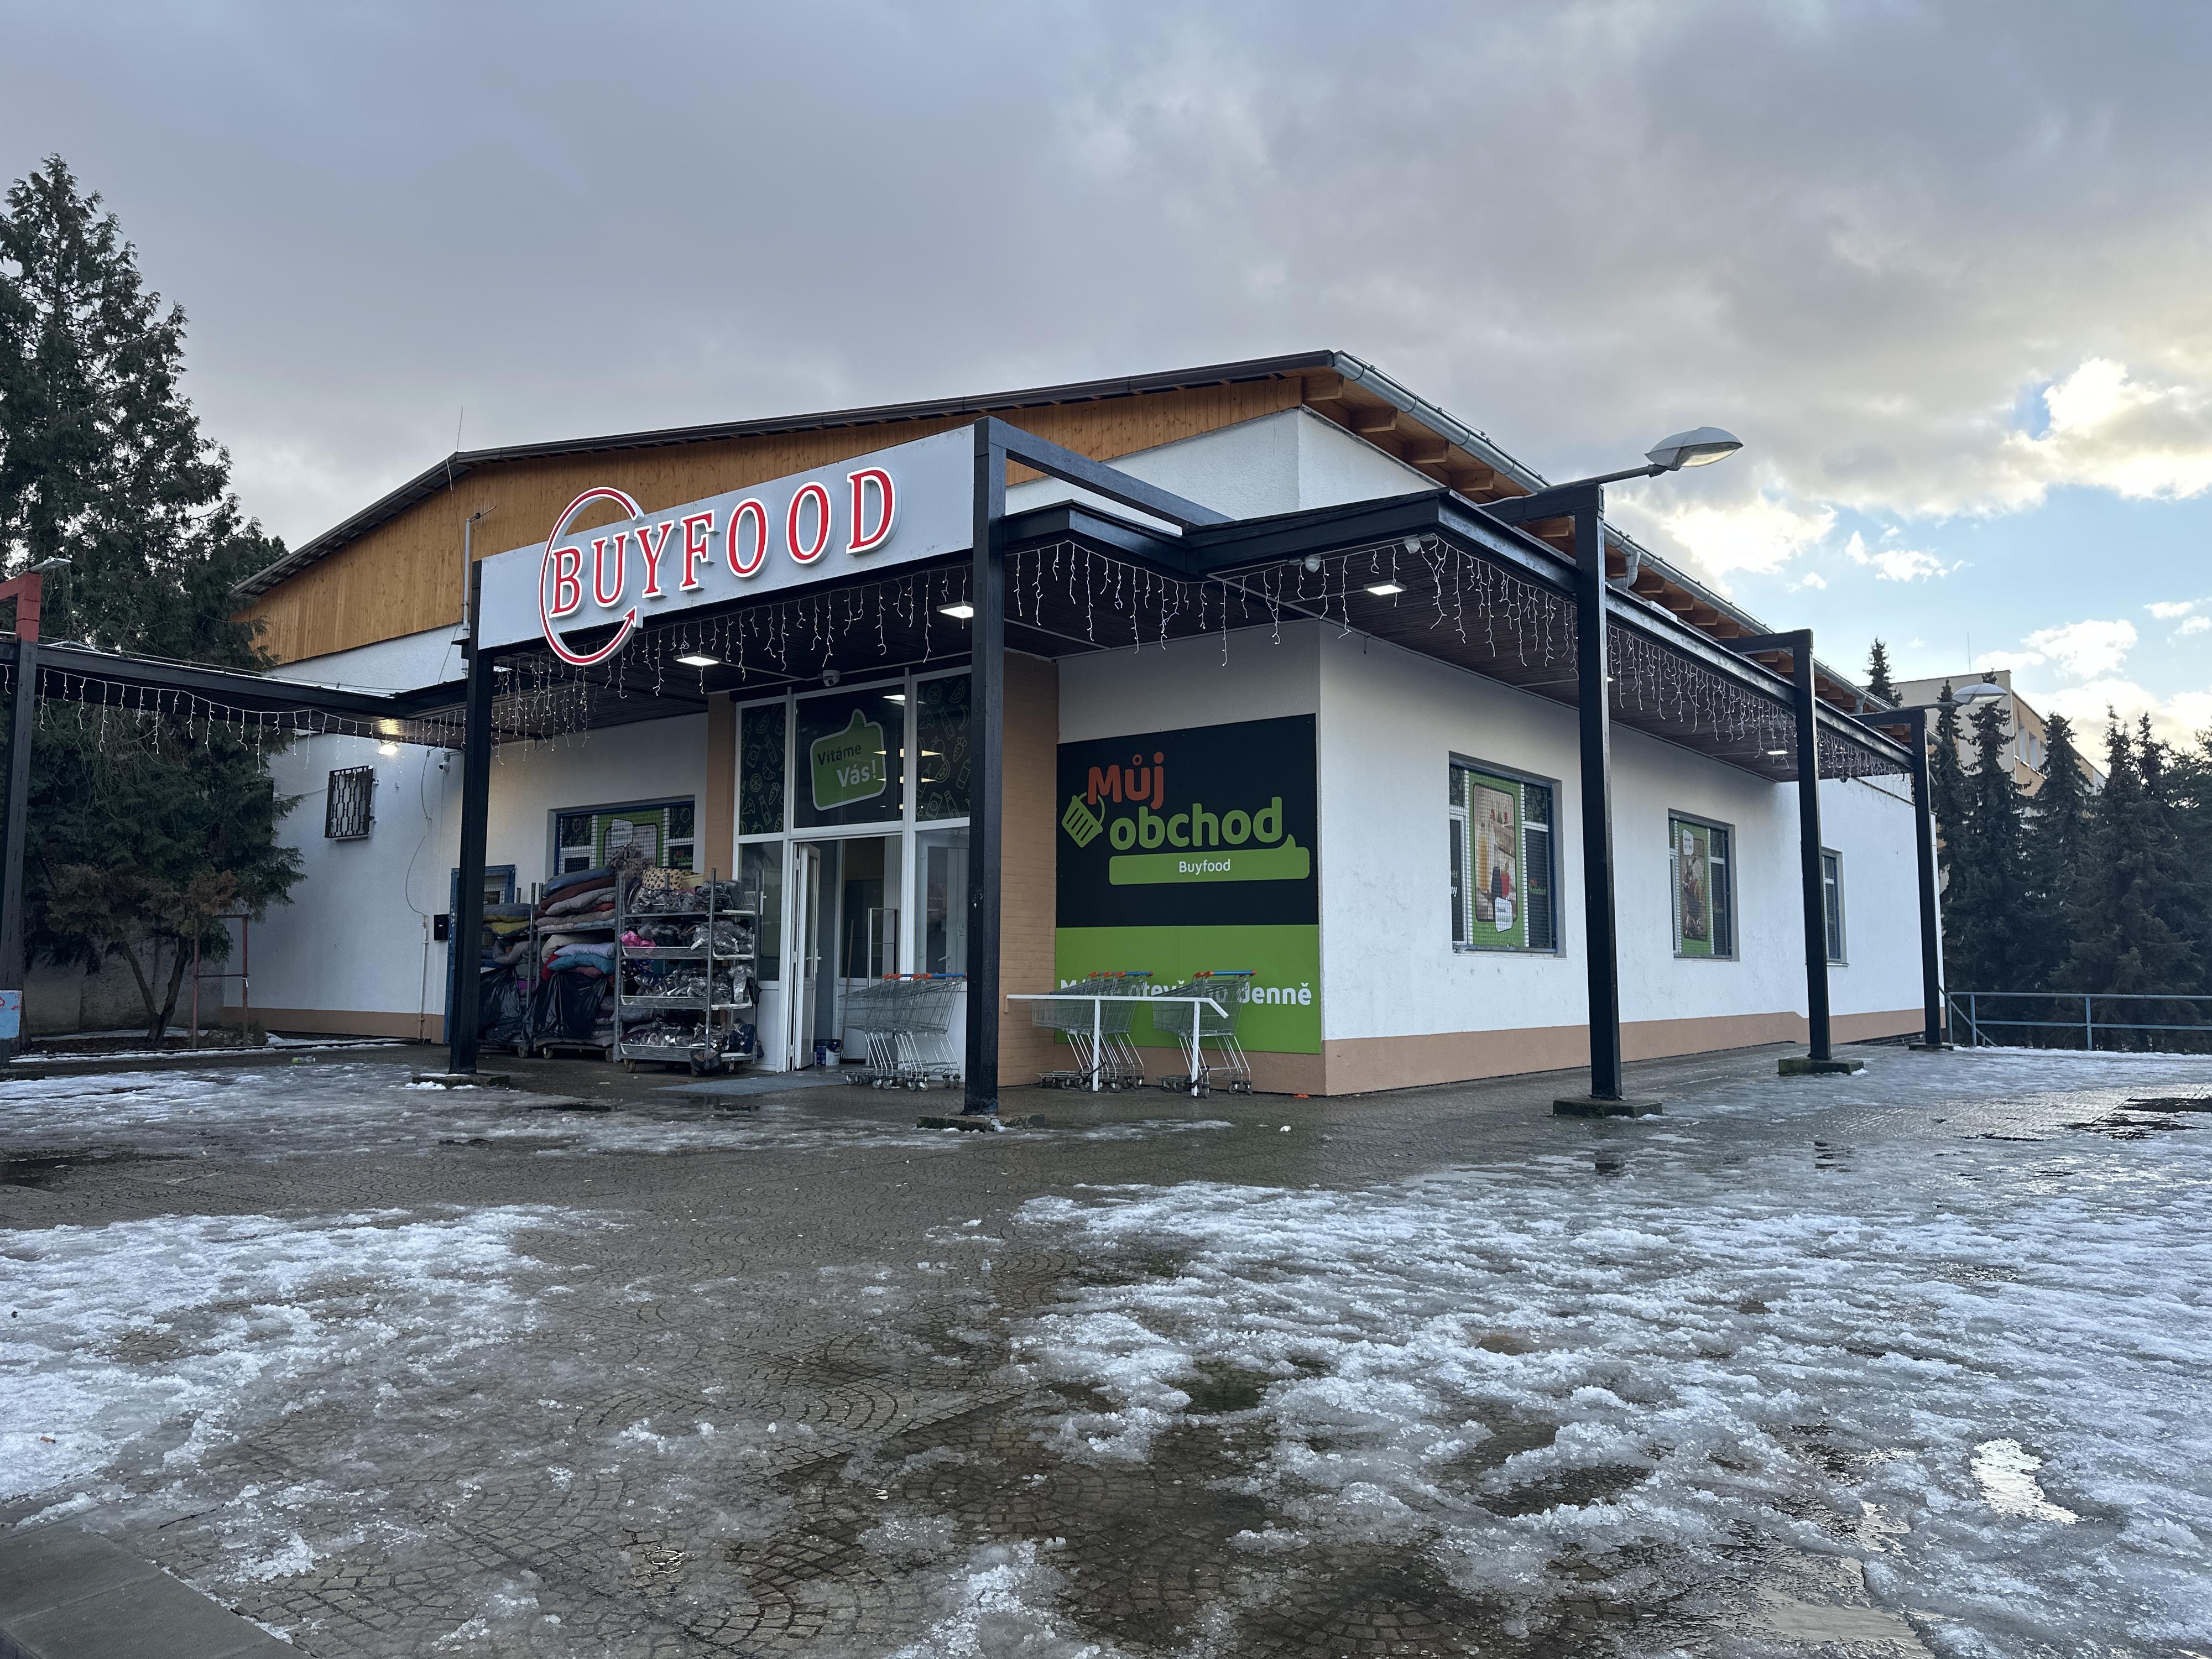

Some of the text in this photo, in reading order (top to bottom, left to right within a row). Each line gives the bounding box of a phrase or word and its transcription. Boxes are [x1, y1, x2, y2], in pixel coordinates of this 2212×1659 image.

[549, 466, 901, 618] BUYFOOD
[818, 744, 862, 765] Vítáme
[836, 759, 877, 787] Vás!
[1087, 752, 1164, 810] Můj
[1109, 796, 1282, 850] obchod
[1178, 858, 1231, 875] Buyfood
